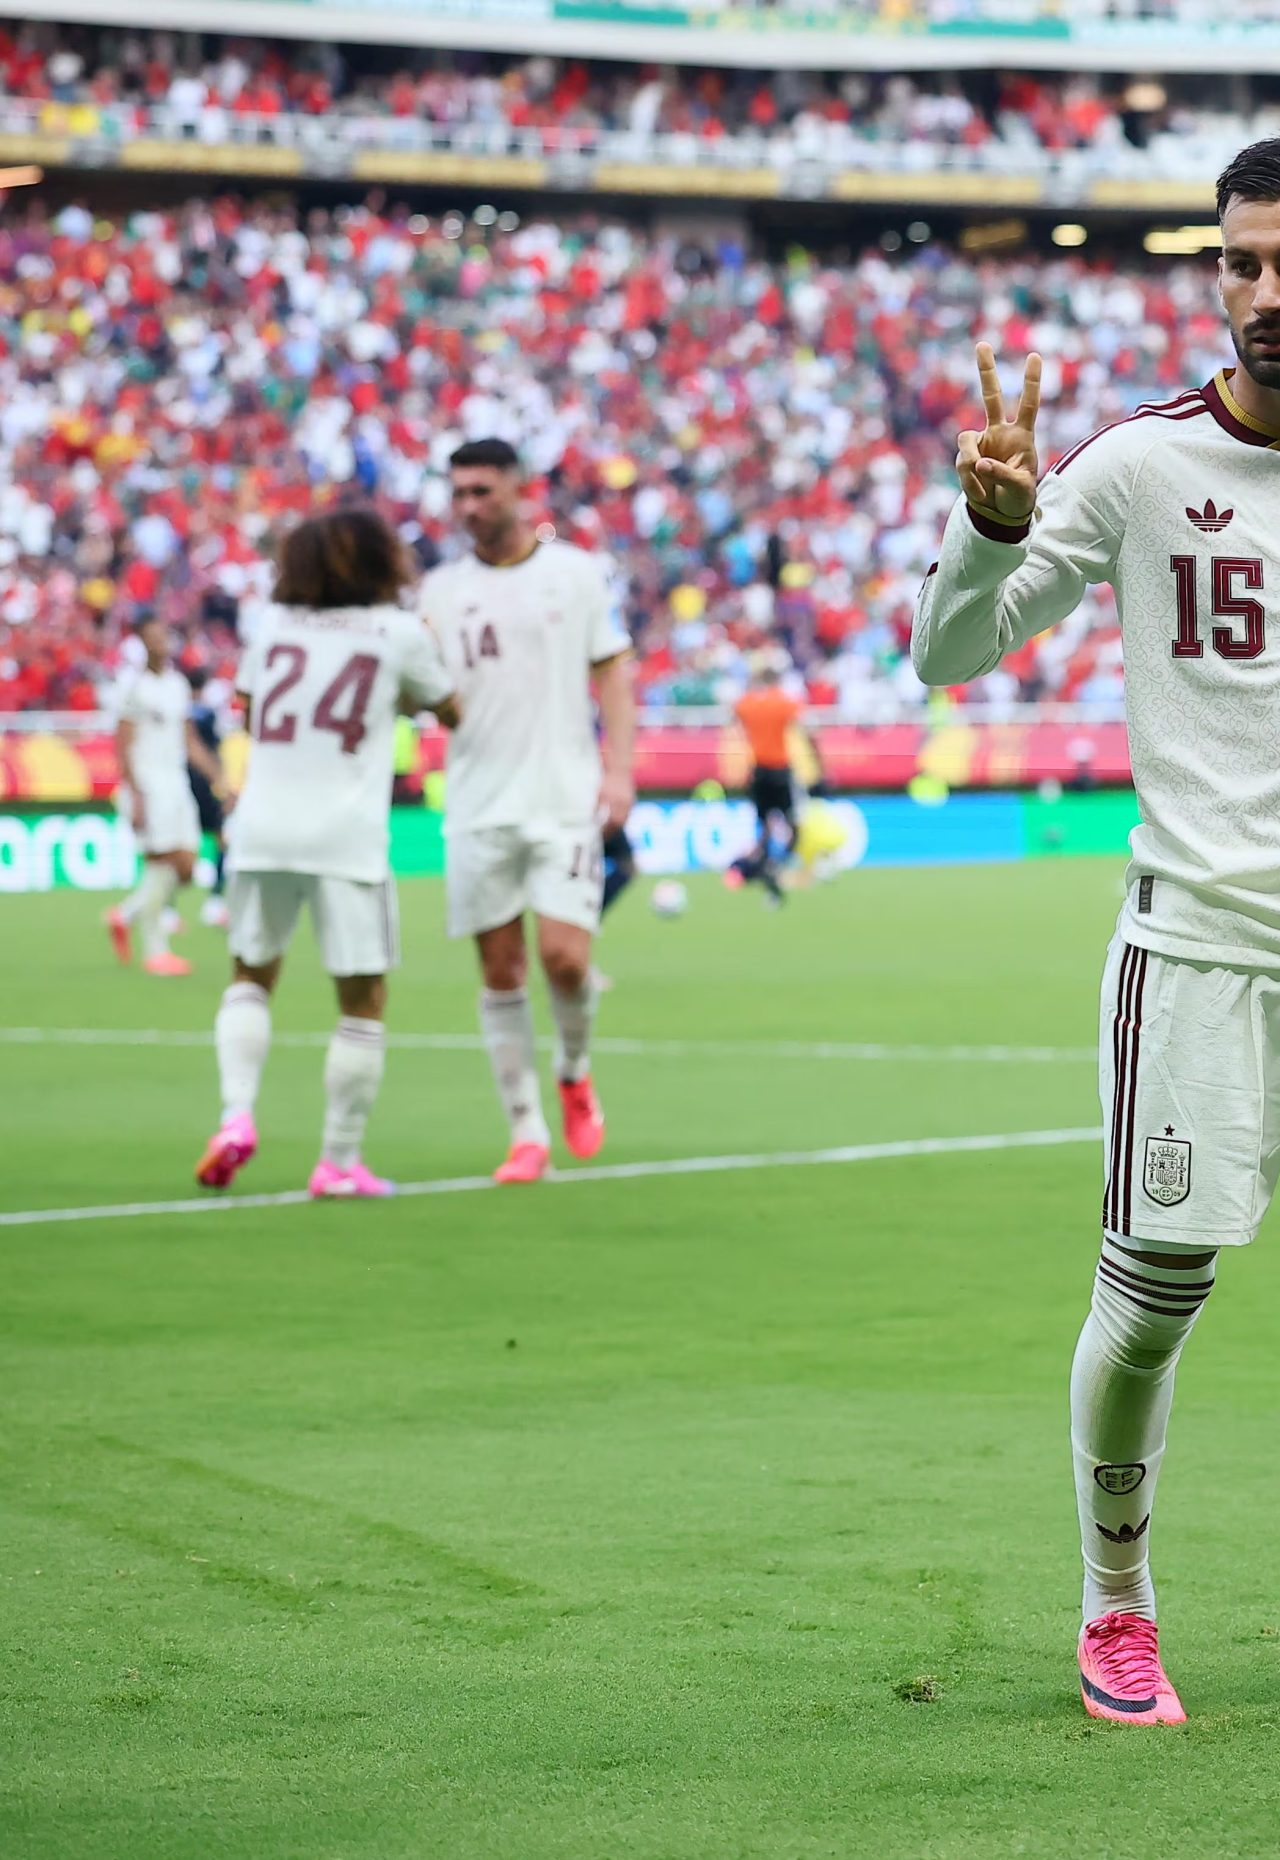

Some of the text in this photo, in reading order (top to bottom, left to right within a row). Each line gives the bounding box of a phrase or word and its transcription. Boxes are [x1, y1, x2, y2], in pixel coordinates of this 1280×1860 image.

[460, 624, 500, 668] 14
[1170, 555, 1265, 659] 15
[258, 644, 380, 754] 24
